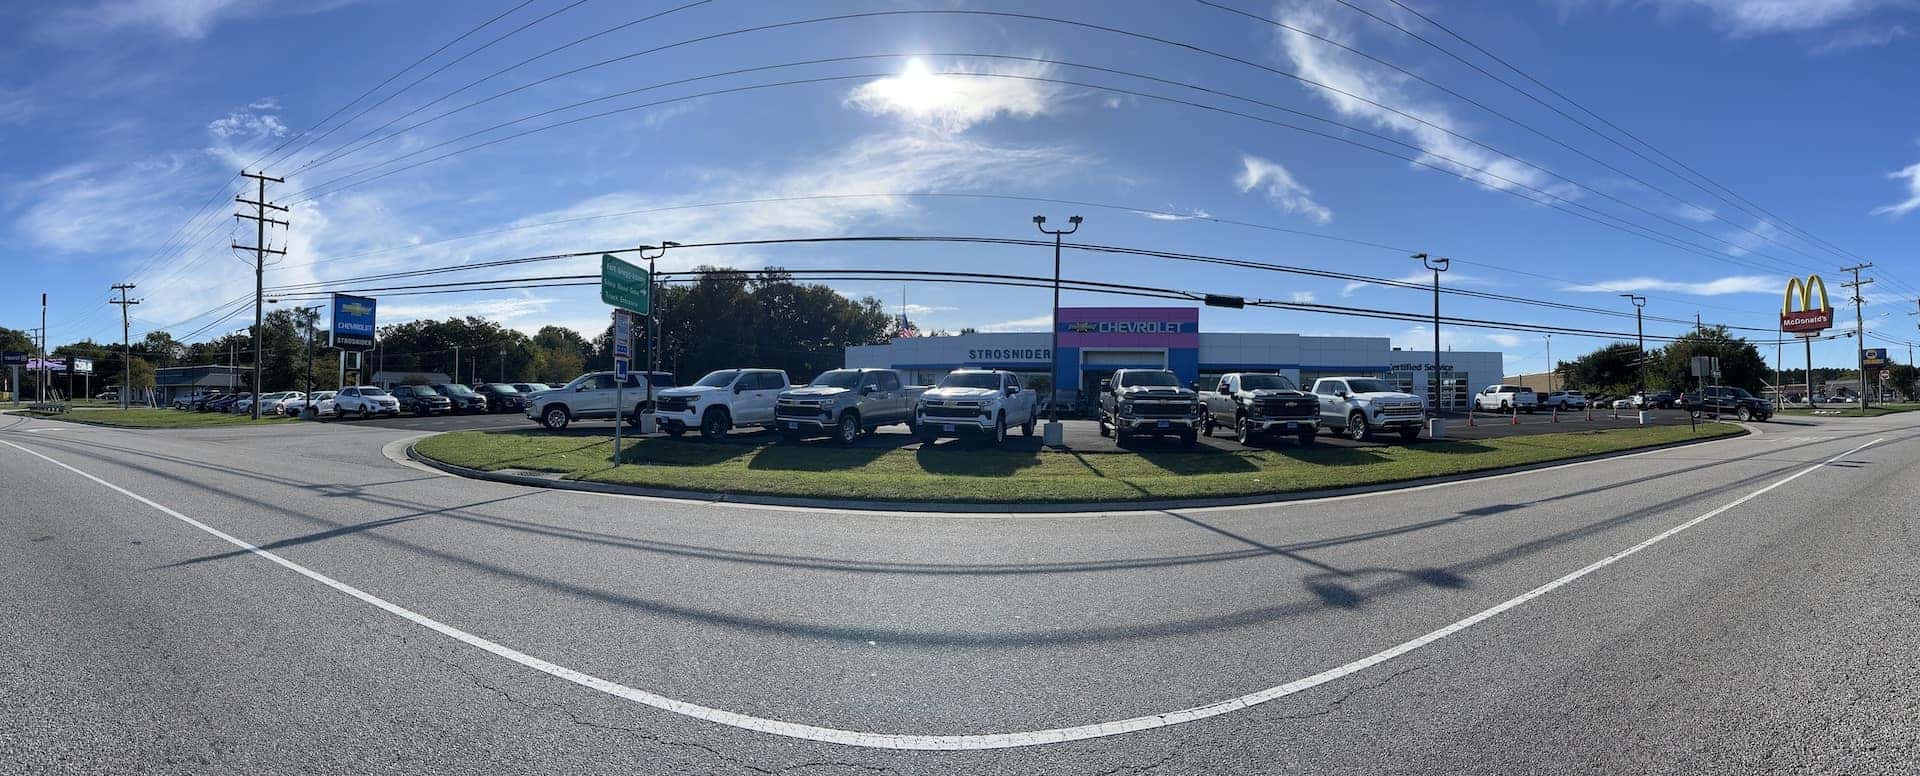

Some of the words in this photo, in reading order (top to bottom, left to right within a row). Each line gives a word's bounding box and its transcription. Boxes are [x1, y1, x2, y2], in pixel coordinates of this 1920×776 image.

[1783, 316, 1827, 326] McDonald's
[338, 322, 372, 331] CHEVROLET
[1099, 321, 1184, 333] CHEVROLET
[968, 348, 1051, 360] STROSNIDER
[1389, 363, 1422, 371] ertified
